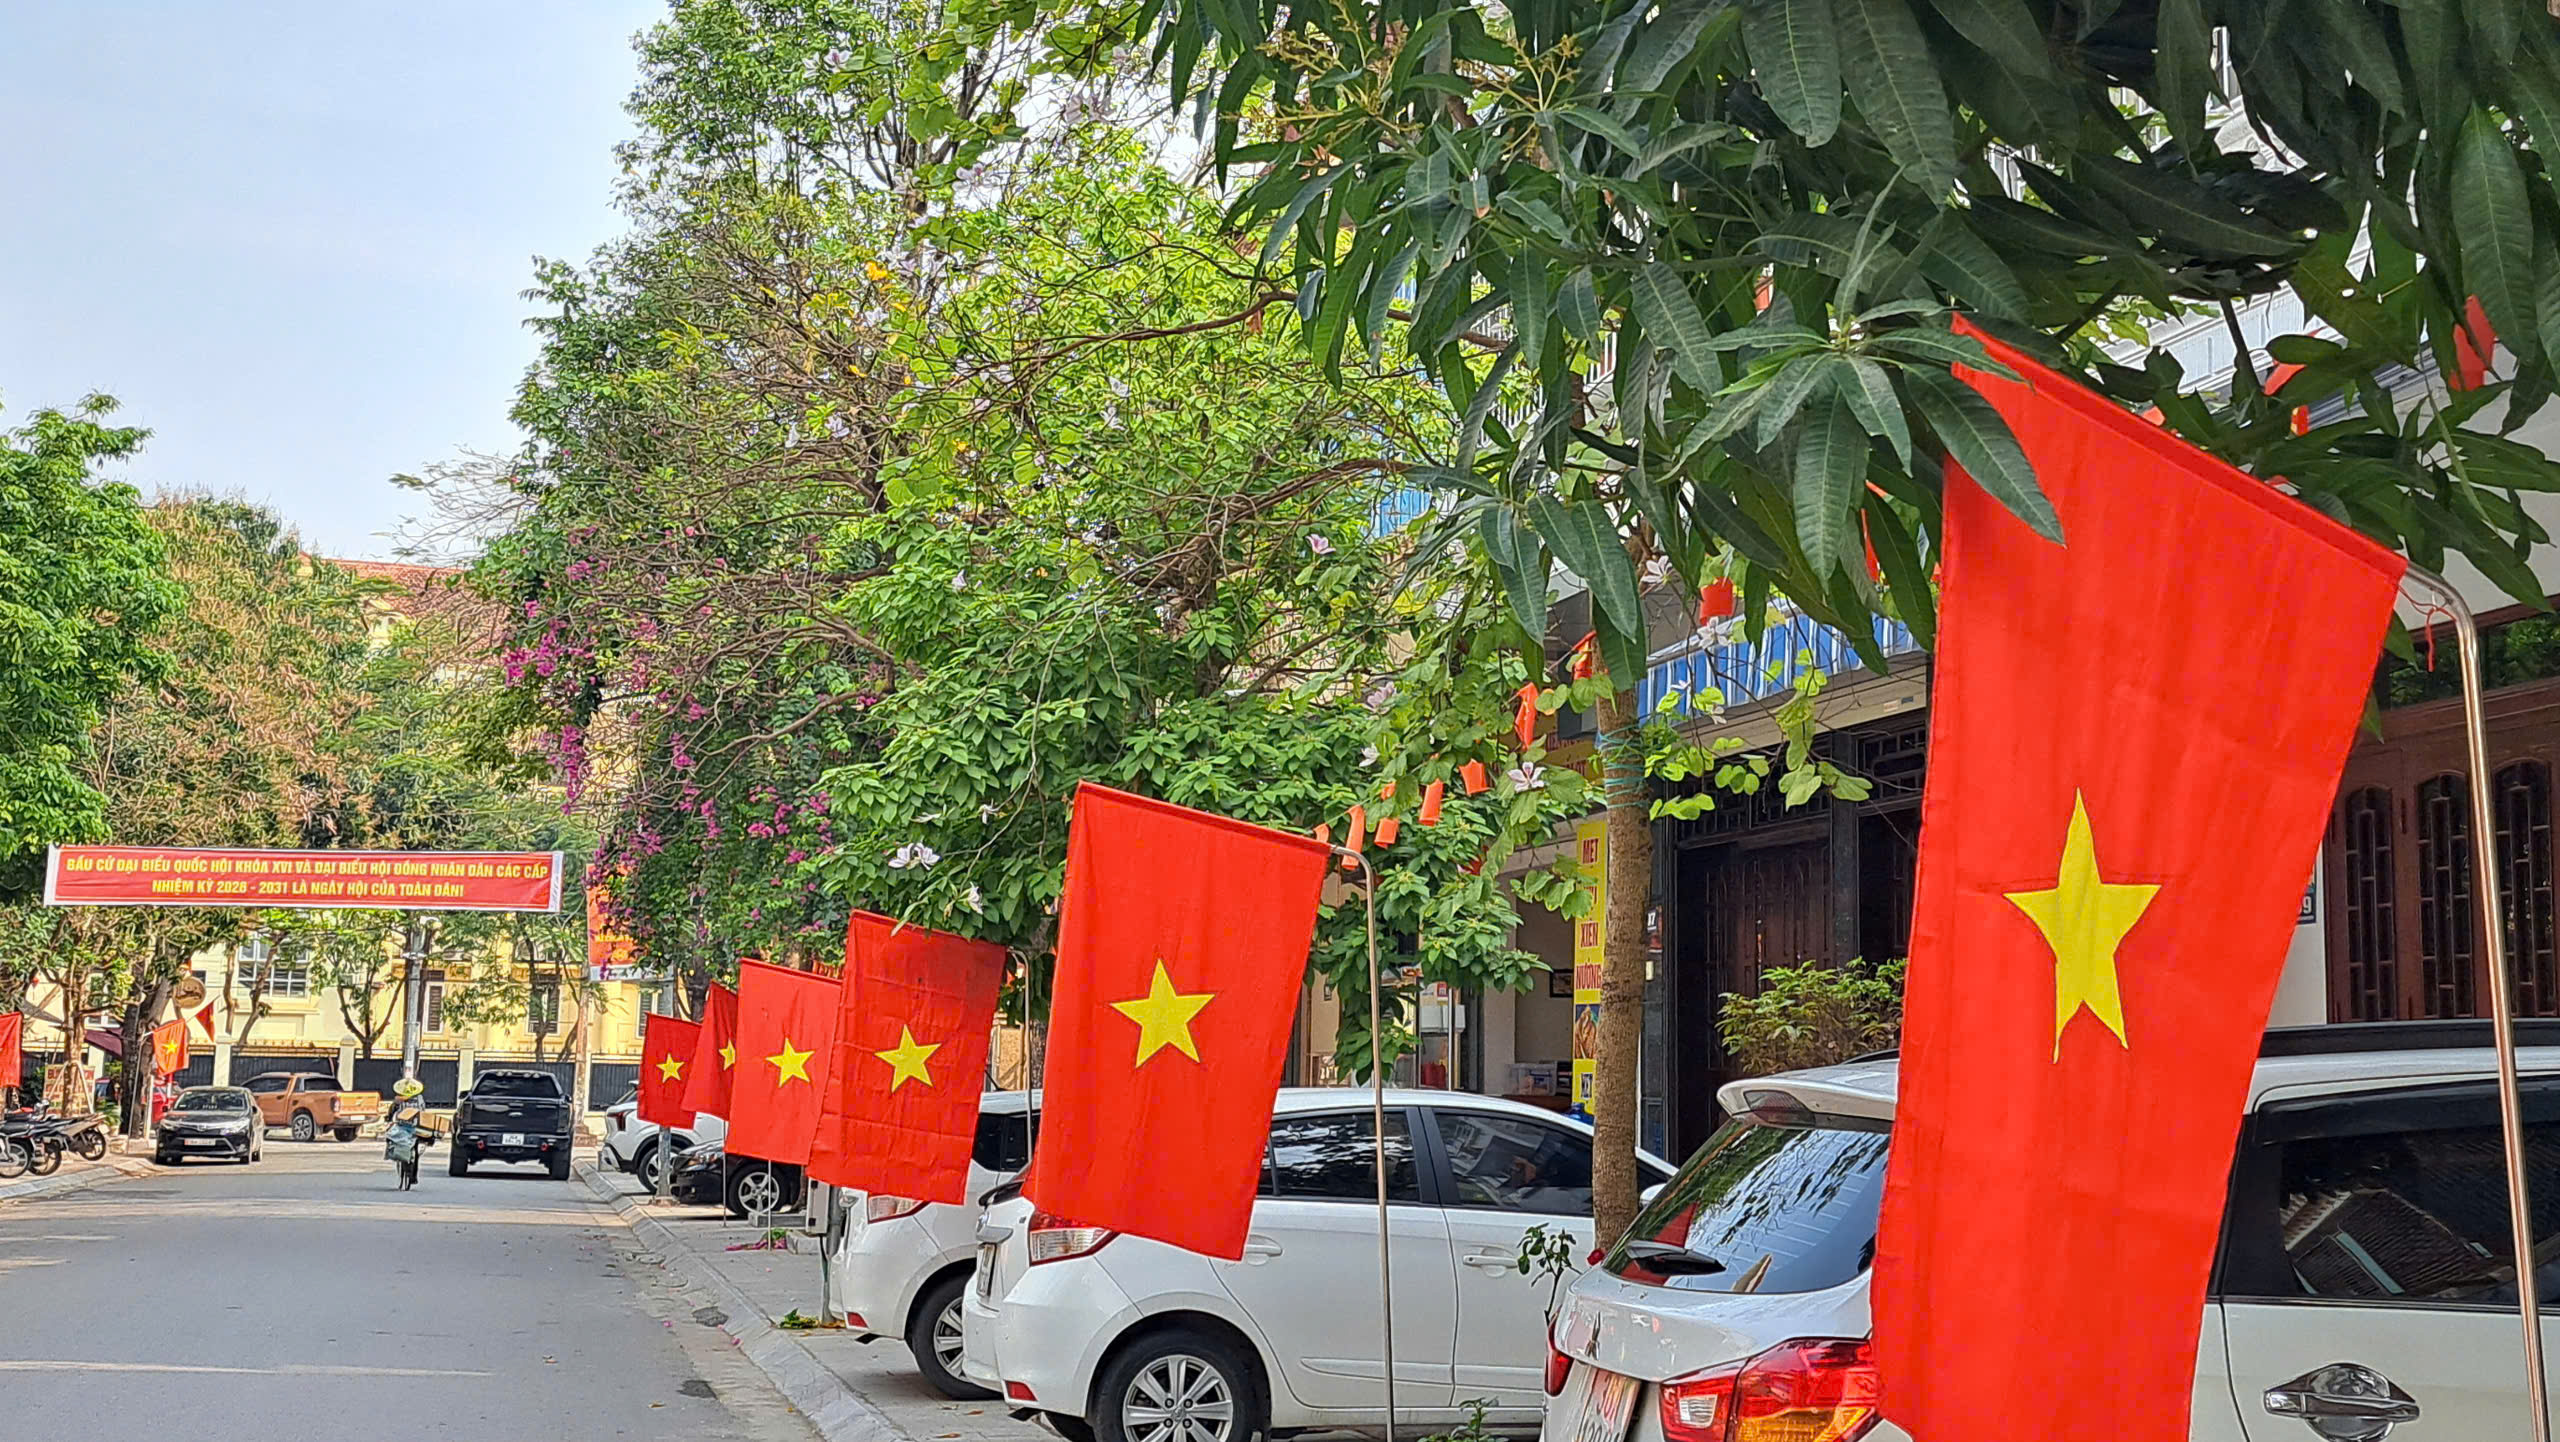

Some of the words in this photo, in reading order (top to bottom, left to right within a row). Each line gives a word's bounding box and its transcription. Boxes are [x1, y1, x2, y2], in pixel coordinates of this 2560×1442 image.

[116, 859, 138, 875] ĐẠI
[174, 855, 208, 873] QUỐC
[210, 858, 232, 876] HỘI
[235, 858, 269, 873] KHÓA
[271, 861, 292, 874] XVI
[295, 859, 311, 874] VÀ
[314, 861, 336, 877] ĐẠI
[370, 860, 391, 878] HỘI
[430, 861, 465, 877] NHÂN
[468, 862, 493, 877] DÂN
[496, 862, 521, 878] CÁC
[524, 861, 549, 879] CẤP
[152, 877, 194, 895] NHIỆM
[259, 881, 288, 894] 2031
[292, 879, 307, 894] LÀ
[311, 880, 344, 895] NGÀY
[347, 880, 368, 898] HỘI
[371, 879, 396, 896] CỦA
[400, 881, 432, 897] TOÀN
